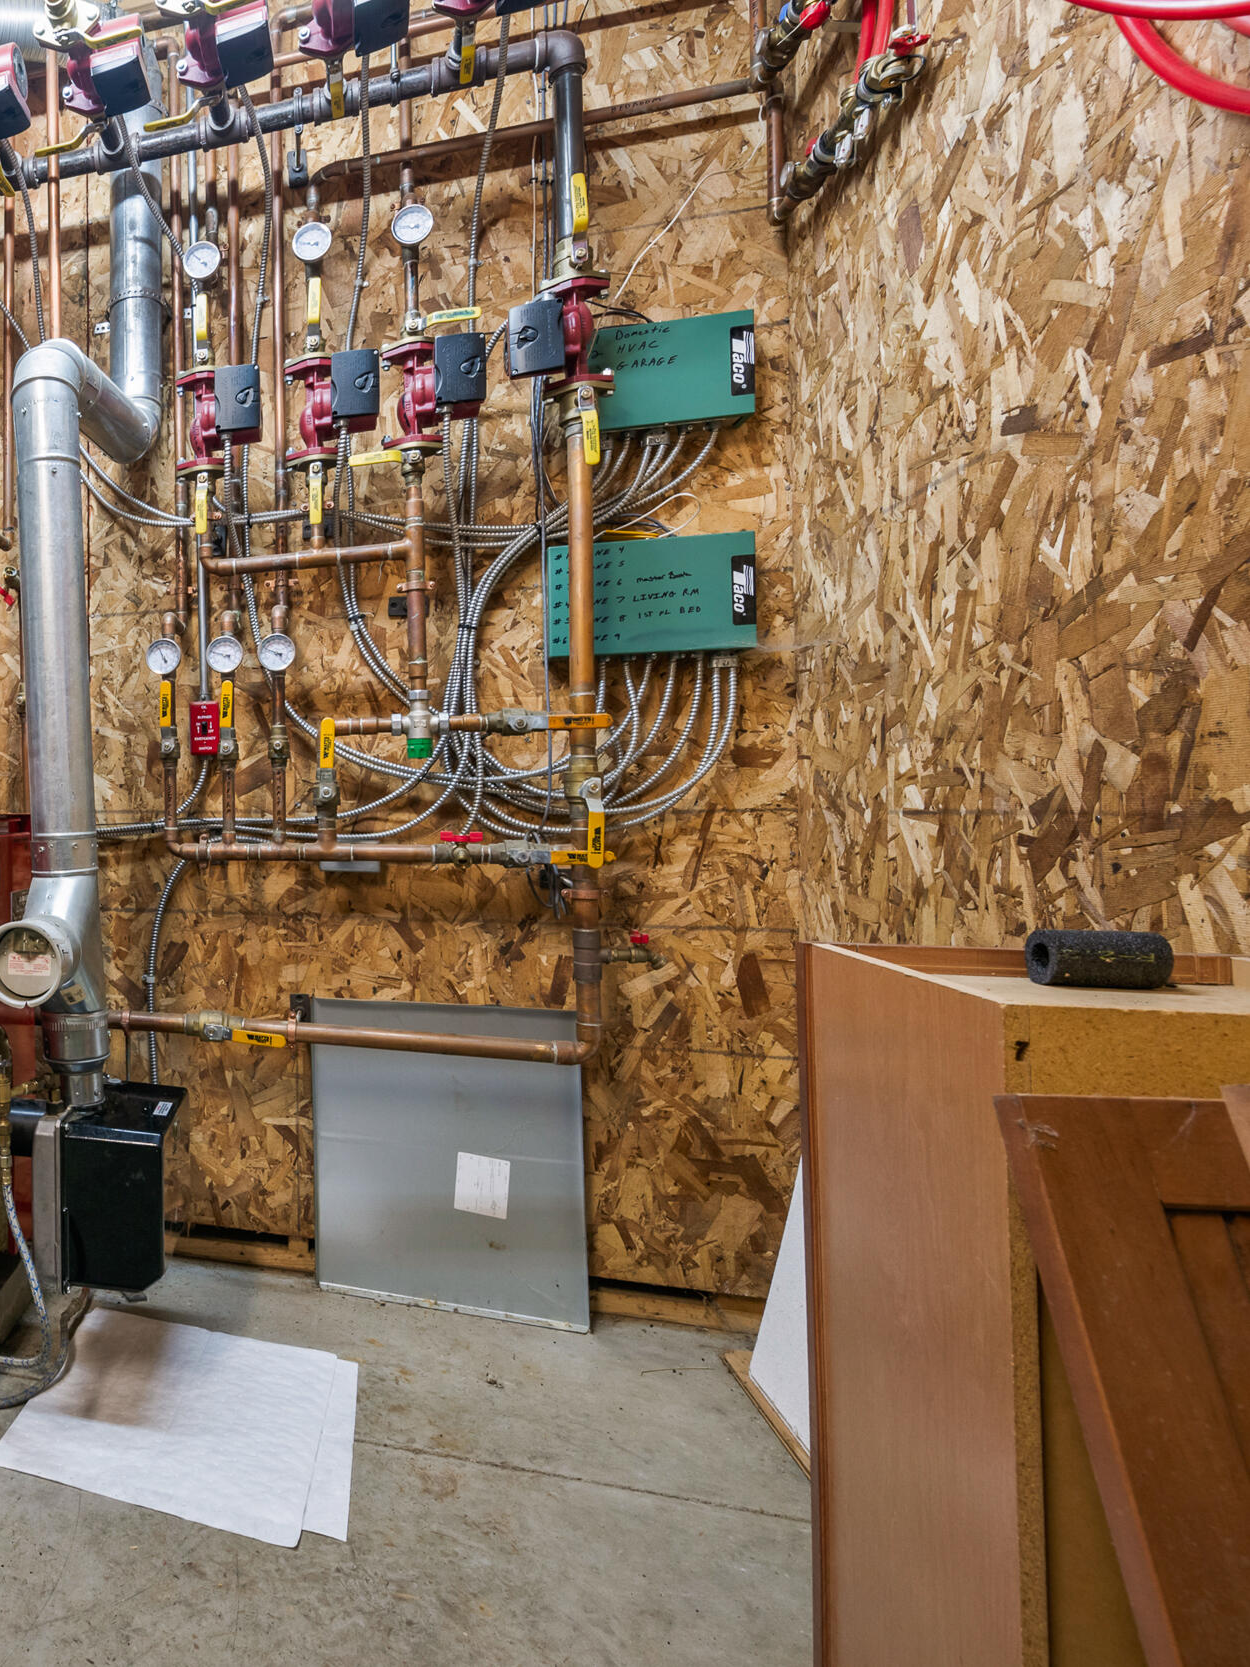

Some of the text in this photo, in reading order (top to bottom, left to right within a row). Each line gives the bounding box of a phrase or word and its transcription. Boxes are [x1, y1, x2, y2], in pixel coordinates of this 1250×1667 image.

[615, 326, 670, 340] Domestic
[617, 340, 659, 354] HVAC
[616, 355, 678, 371] GARAGE
[732, 330, 754, 386] Taco
[633, 591, 676, 602] LIVING
[733, 565, 754, 614] Taco
